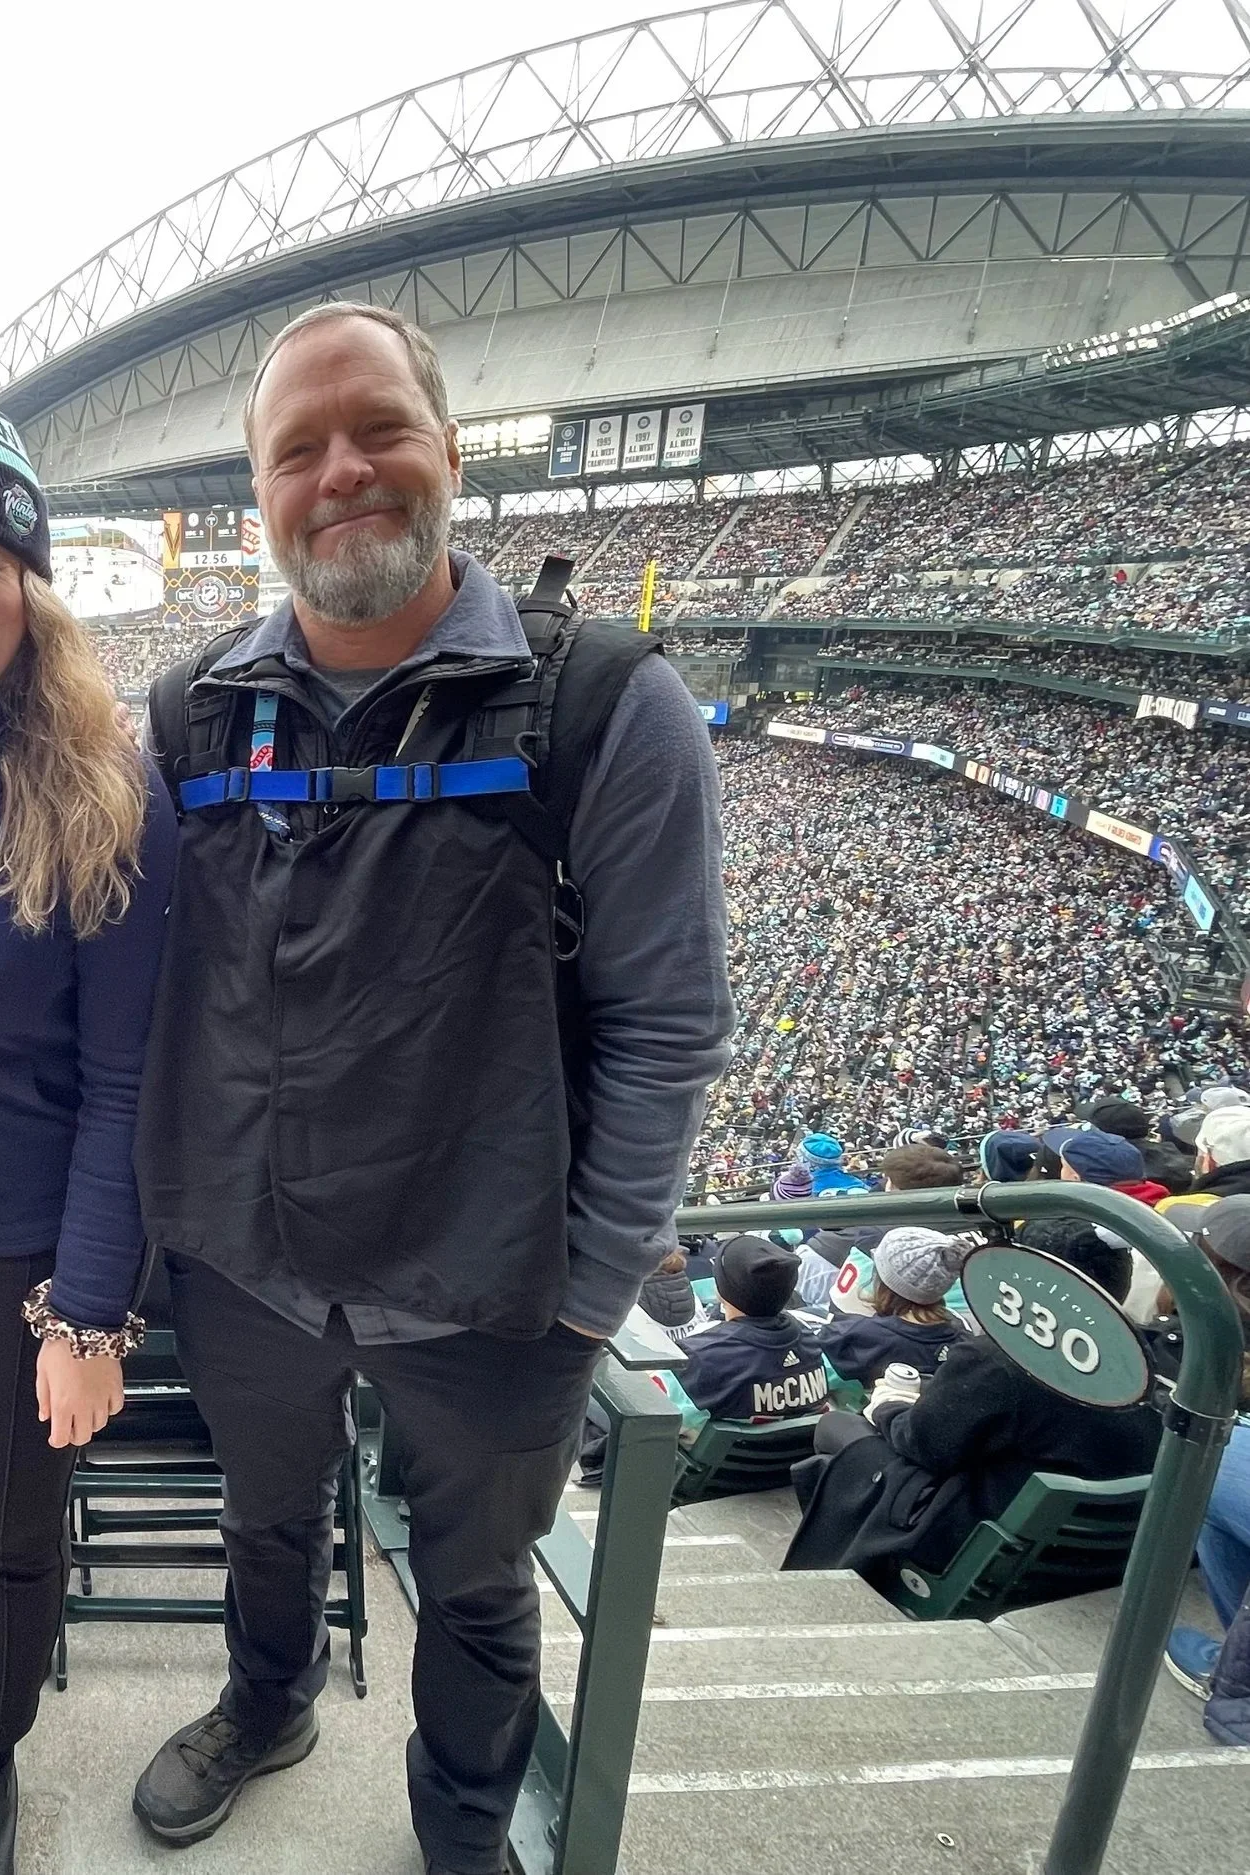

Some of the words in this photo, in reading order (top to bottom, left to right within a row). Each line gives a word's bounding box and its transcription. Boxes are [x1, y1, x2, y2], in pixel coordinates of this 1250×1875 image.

[635, 432, 650, 442] 1997
[676, 427, 693, 437] 2001
[666, 448, 699, 459] CHAMPIONS
[992, 1281, 1100, 1374] 330
